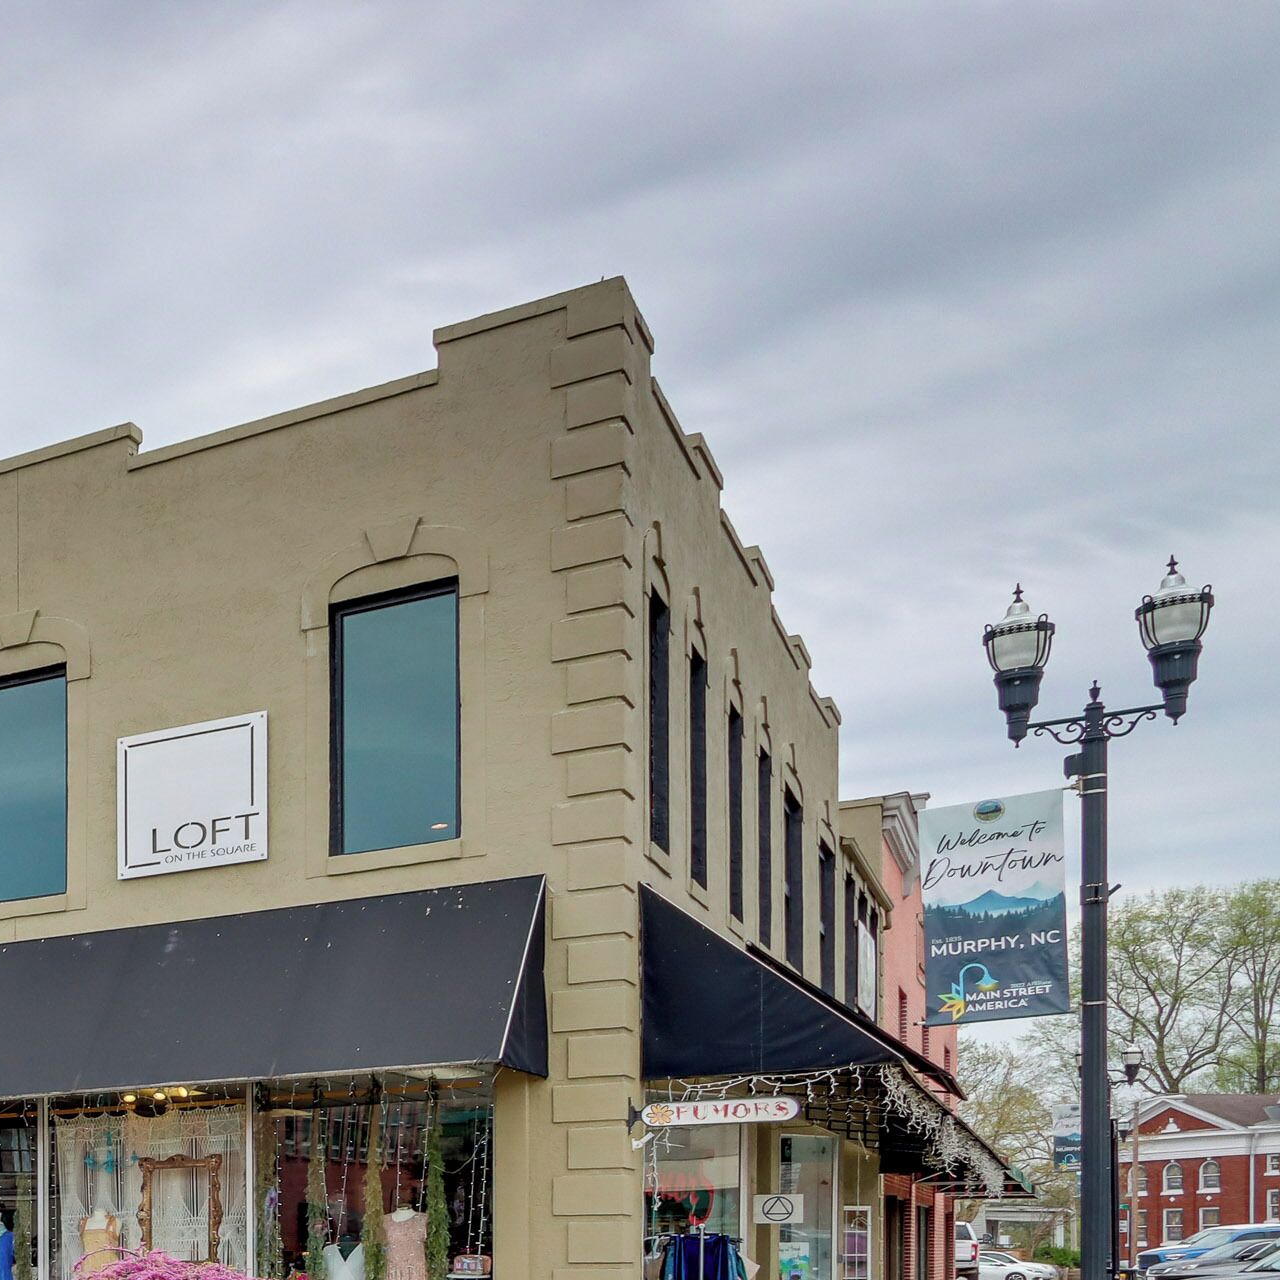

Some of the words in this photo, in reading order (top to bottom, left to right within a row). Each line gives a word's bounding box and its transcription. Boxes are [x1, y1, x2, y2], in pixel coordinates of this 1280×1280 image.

[152, 812, 260, 854] LOFT
[936, 829, 1023, 854] Welcome
[1023, 820, 1047, 842] to
[164, 853, 183, 864] ON
[186, 850, 207, 861] THE
[210, 842, 257, 857] SQUARE
[922, 848, 1064, 890] Downtown
[931, 934, 1025, 957] MURPHY,
[1030, 929, 1061, 946] NC
[965, 989, 1001, 1002] MAIN
[1002, 984, 1053, 998] STREET
[965, 998, 1028, 1013] AMERICA
